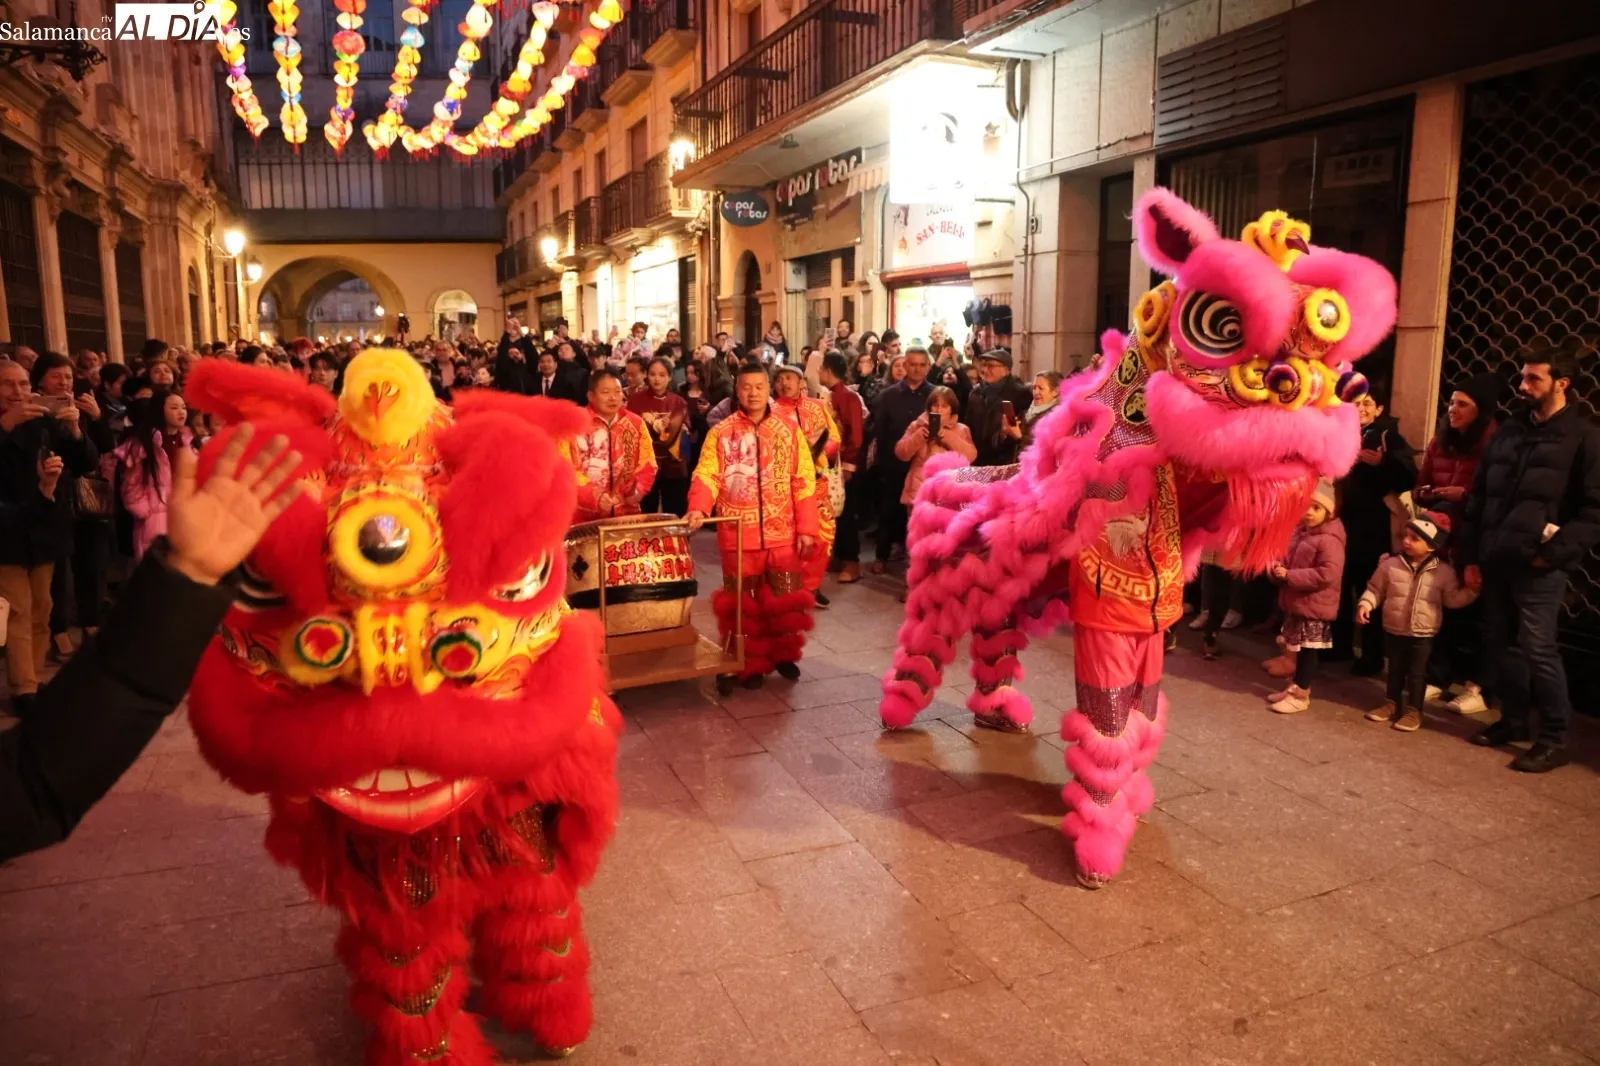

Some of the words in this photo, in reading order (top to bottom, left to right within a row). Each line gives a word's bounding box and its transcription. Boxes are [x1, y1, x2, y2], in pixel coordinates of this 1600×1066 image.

[776, 172, 812, 207] copas
[814, 155, 858, 190] rotas
[724, 201, 754, 211] copas
[738, 210, 767, 218] rotas
